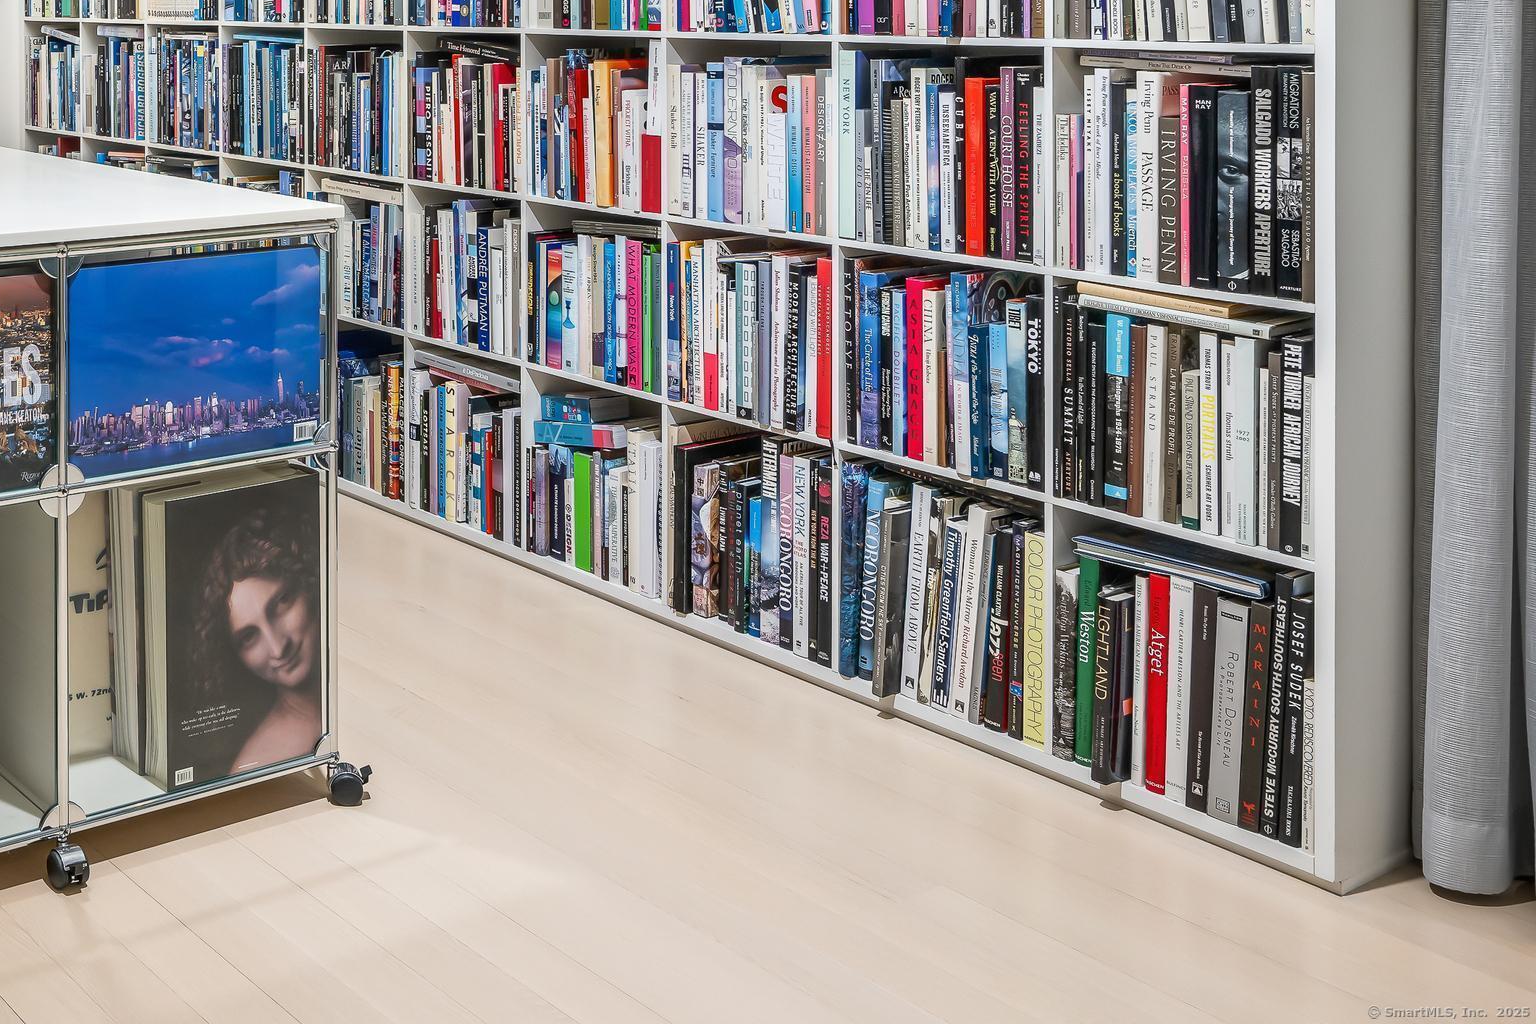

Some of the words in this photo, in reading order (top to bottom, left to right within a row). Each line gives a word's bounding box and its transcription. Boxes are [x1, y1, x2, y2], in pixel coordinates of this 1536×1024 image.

[447, 42, 460, 50] Time
[462, 45, 480, 55] Honored
[137, 53, 145, 95] ROGERS
[1140, 80, 1154, 112] Irving
[137, 96, 145, 138] RICHARD
[955, 96, 964, 143] CUBA
[1143, 112, 1154, 134] Penn
[1254, 88, 1272, 146] SALGADO
[1289, 73, 1299, 130] MIGRATIONS
[425, 124, 433, 179] LISSONI
[697, 126, 705, 166] SHAKER
[1018, 103, 1028, 159] FEELING
[1019, 164, 1028, 189] THE
[1141, 151, 1154, 213] PASSAGE
[1161, 130, 1176, 208] IRVING
[1254, 149, 1272, 211] WORKERS
[1018, 194, 1028, 236] SPIRIT
[478, 232, 487, 279] ANDRÉE
[627, 245, 636, 282] WHAT
[1161, 216, 1177, 274] PENN
[1254, 213, 1271, 277] APERTURE
[1281, 228, 1290, 267] SALGADO
[1290, 230, 1300, 269] SEBASTIÃO
[479, 281, 488, 331] PUTMAN
[628, 286, 637, 342] MODERN
[1007, 308, 1021, 330] TIBET
[629, 346, 637, 372] WAS
[1027, 318, 1038, 374] TOKYO
[1285, 343, 1302, 369] PETE
[1284, 371, 1302, 410] TURNER
[1064, 387, 1073, 446] SUMMIT
[1200, 394, 1215, 462] PORTRAITS
[1283, 412, 1301, 455] AFRICAN
[445, 387, 455, 502] STARCK
[763, 439, 777, 499] AFTERMATH
[1283, 457, 1302, 508] JOURNEY
[780, 490, 793, 612] NGORONGORO
[821, 515, 829, 540] REZA
[946, 527, 959, 576] Timothy
[819, 542, 829, 602] WAR+PEACE
[1027, 539, 1044, 609] COLOR
[936, 578, 953, 684] Greenfield-Sanders
[1079, 609, 1095, 663] Weston
[1148, 627, 1165, 676] Atget
[1273, 596, 1288, 671] SOUTHEAST
[1292, 612, 1306, 657] JOSEF
[1026, 612, 1044, 736] PHOTOGRAPHY
[1248, 624, 1268, 748] MARAINI
[1272, 673, 1284, 715] SOUTH
[1289, 663, 1303, 710] SUDEK
[1267, 716, 1280, 776] McCURRY
[1264, 778, 1276, 818] STEVE
